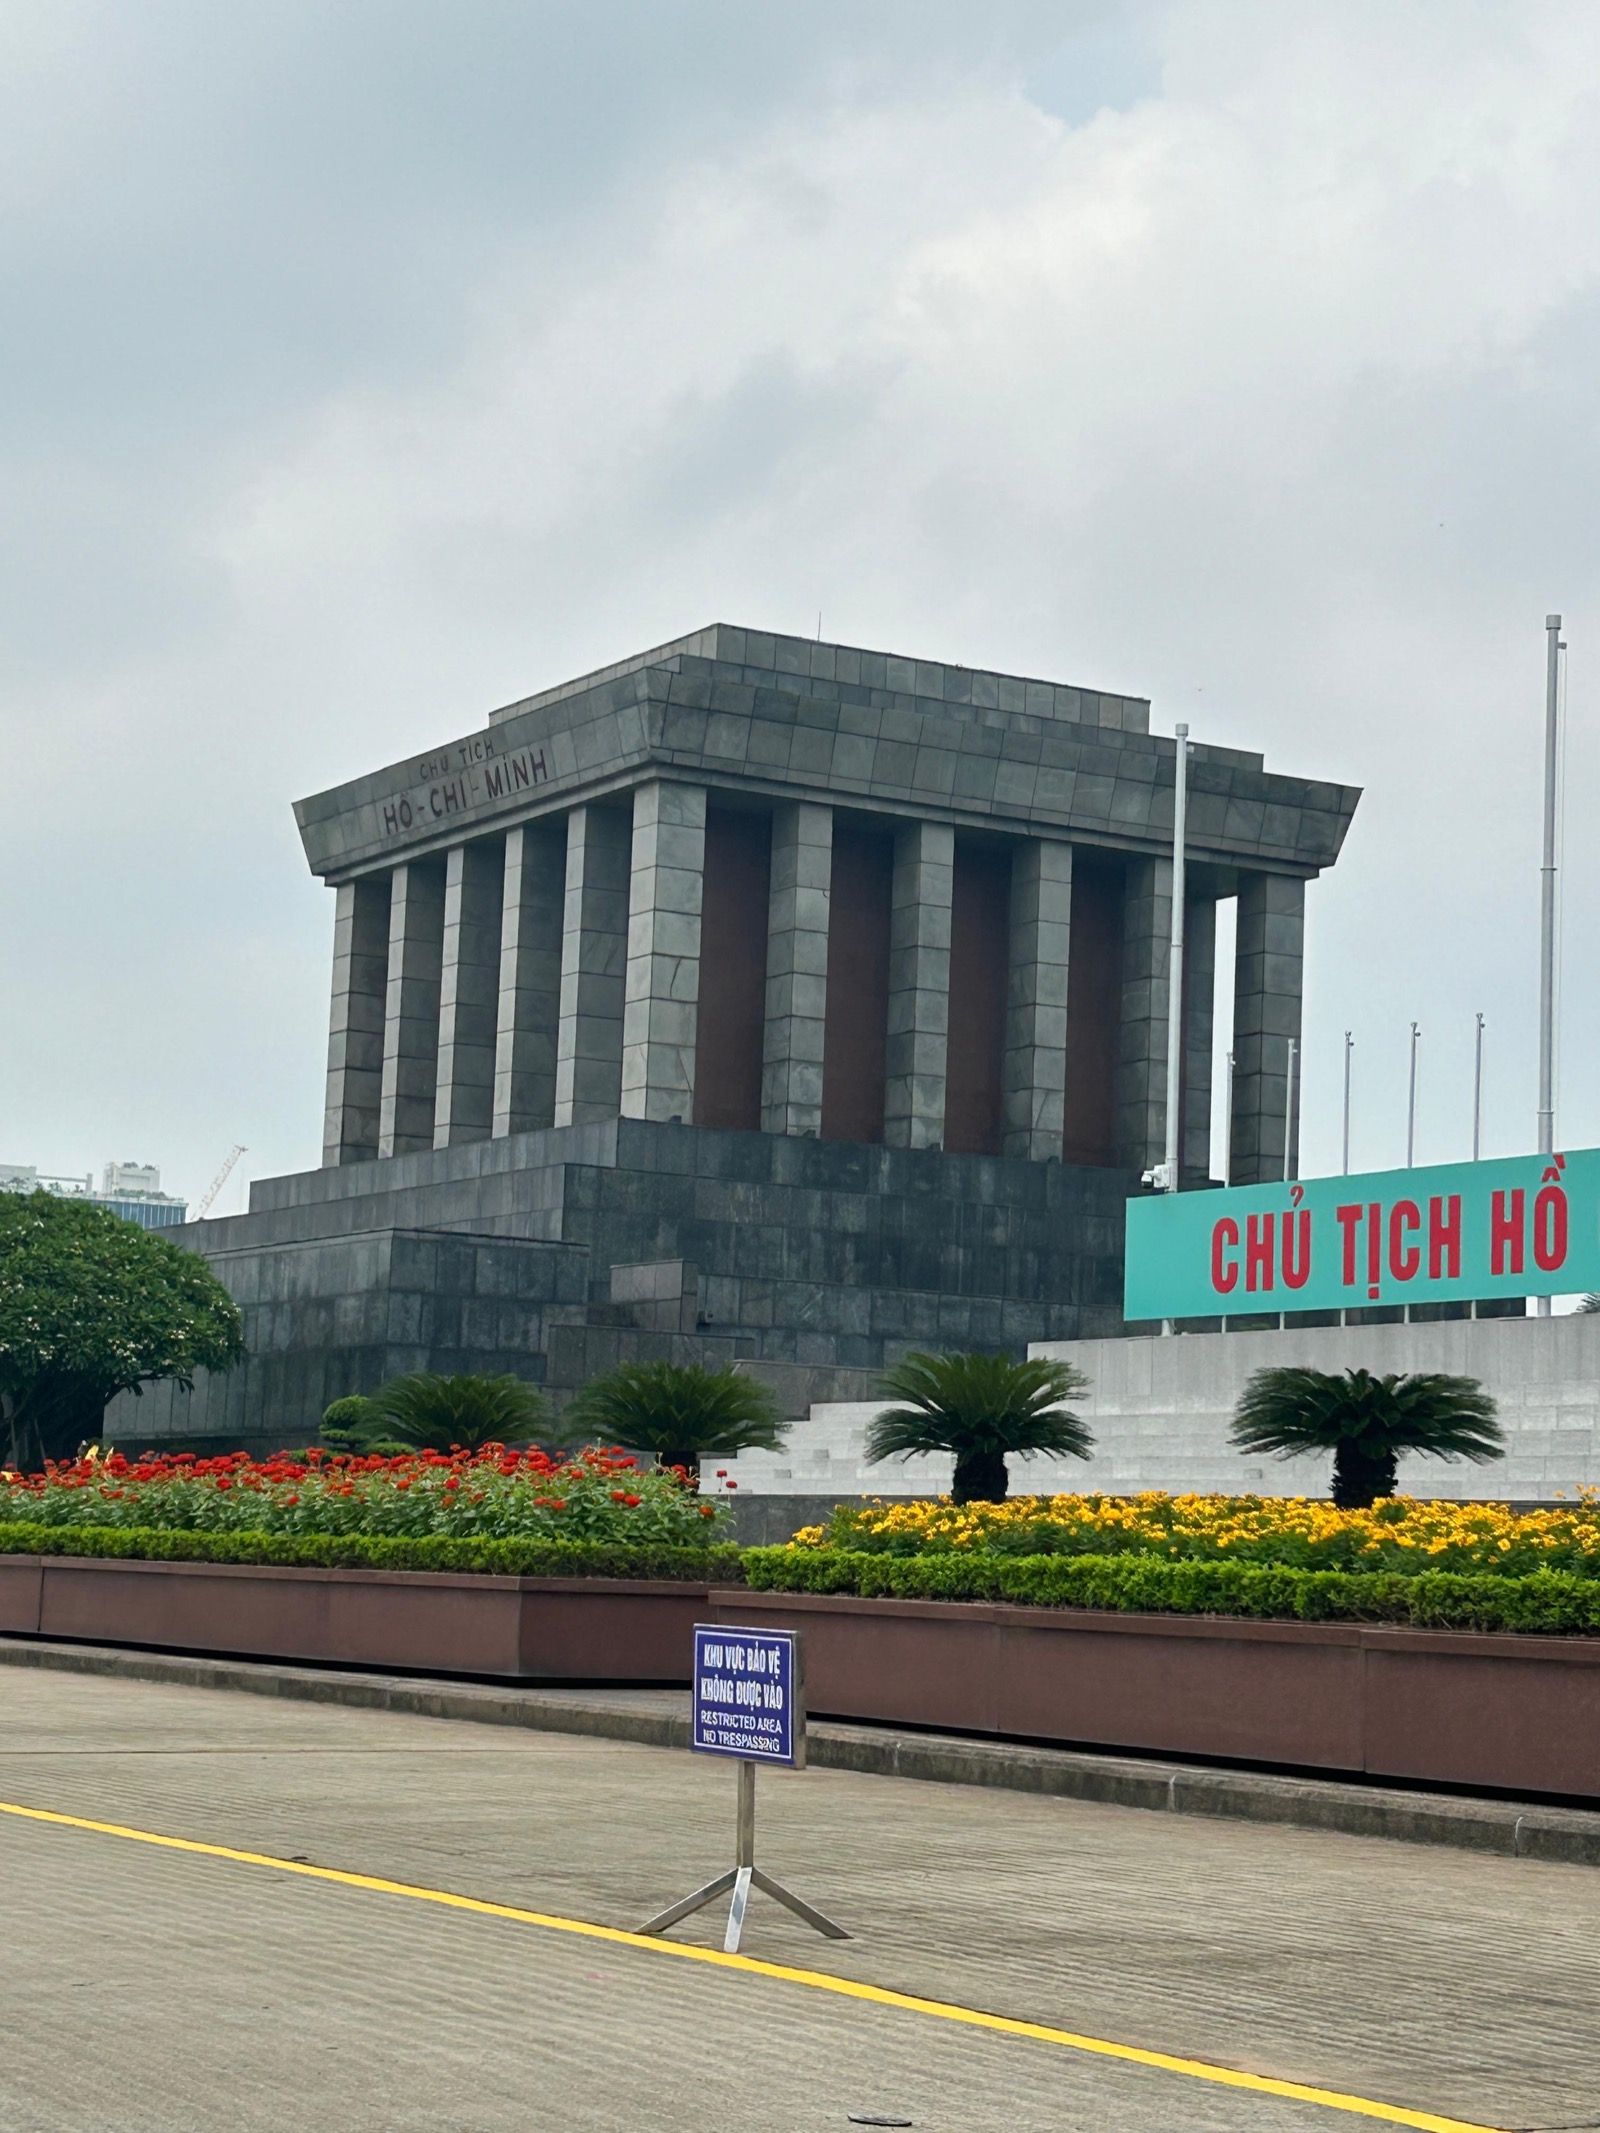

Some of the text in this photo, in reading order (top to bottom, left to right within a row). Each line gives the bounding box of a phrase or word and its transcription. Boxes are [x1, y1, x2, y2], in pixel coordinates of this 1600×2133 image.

[1211, 1153, 1568, 1300] CHỦ TỊCH HỒ
[704, 1641, 780, 1680] KHU VỰC BẢO VỆ
[701, 1674, 783, 1712] KHÔNG ĐƯỢC VÀO
[701, 1709, 783, 1734] RESTRICTED AREA
[703, 1728, 780, 1752] NO TRESPASSING
